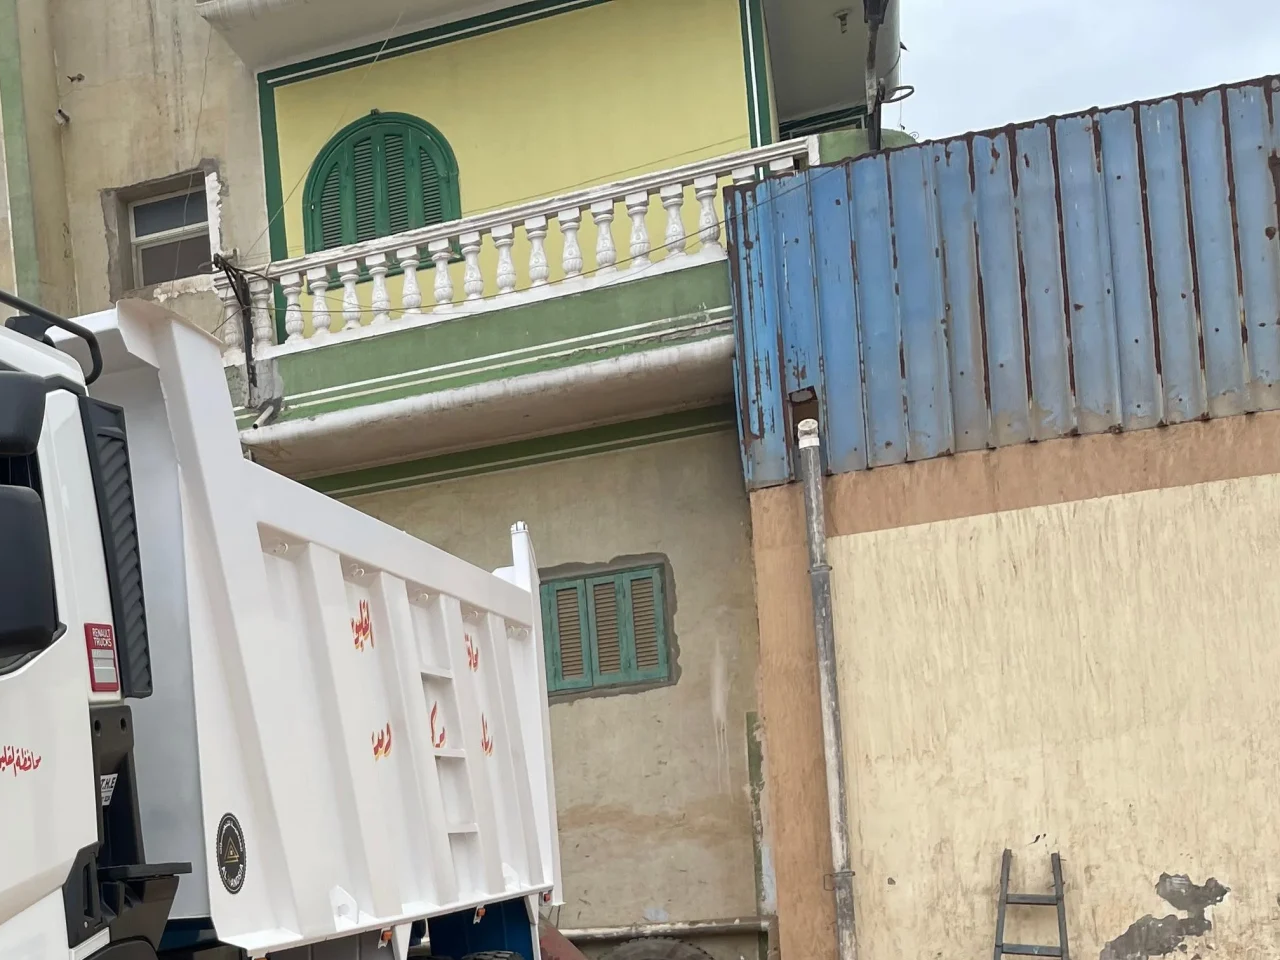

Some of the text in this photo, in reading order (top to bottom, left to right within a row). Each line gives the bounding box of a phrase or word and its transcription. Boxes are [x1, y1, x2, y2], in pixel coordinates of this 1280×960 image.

[92, 628, 111, 638] RENAULT
[93, 638, 113, 647] TRUCKS
[16, 747, 41, 771] محافظة
